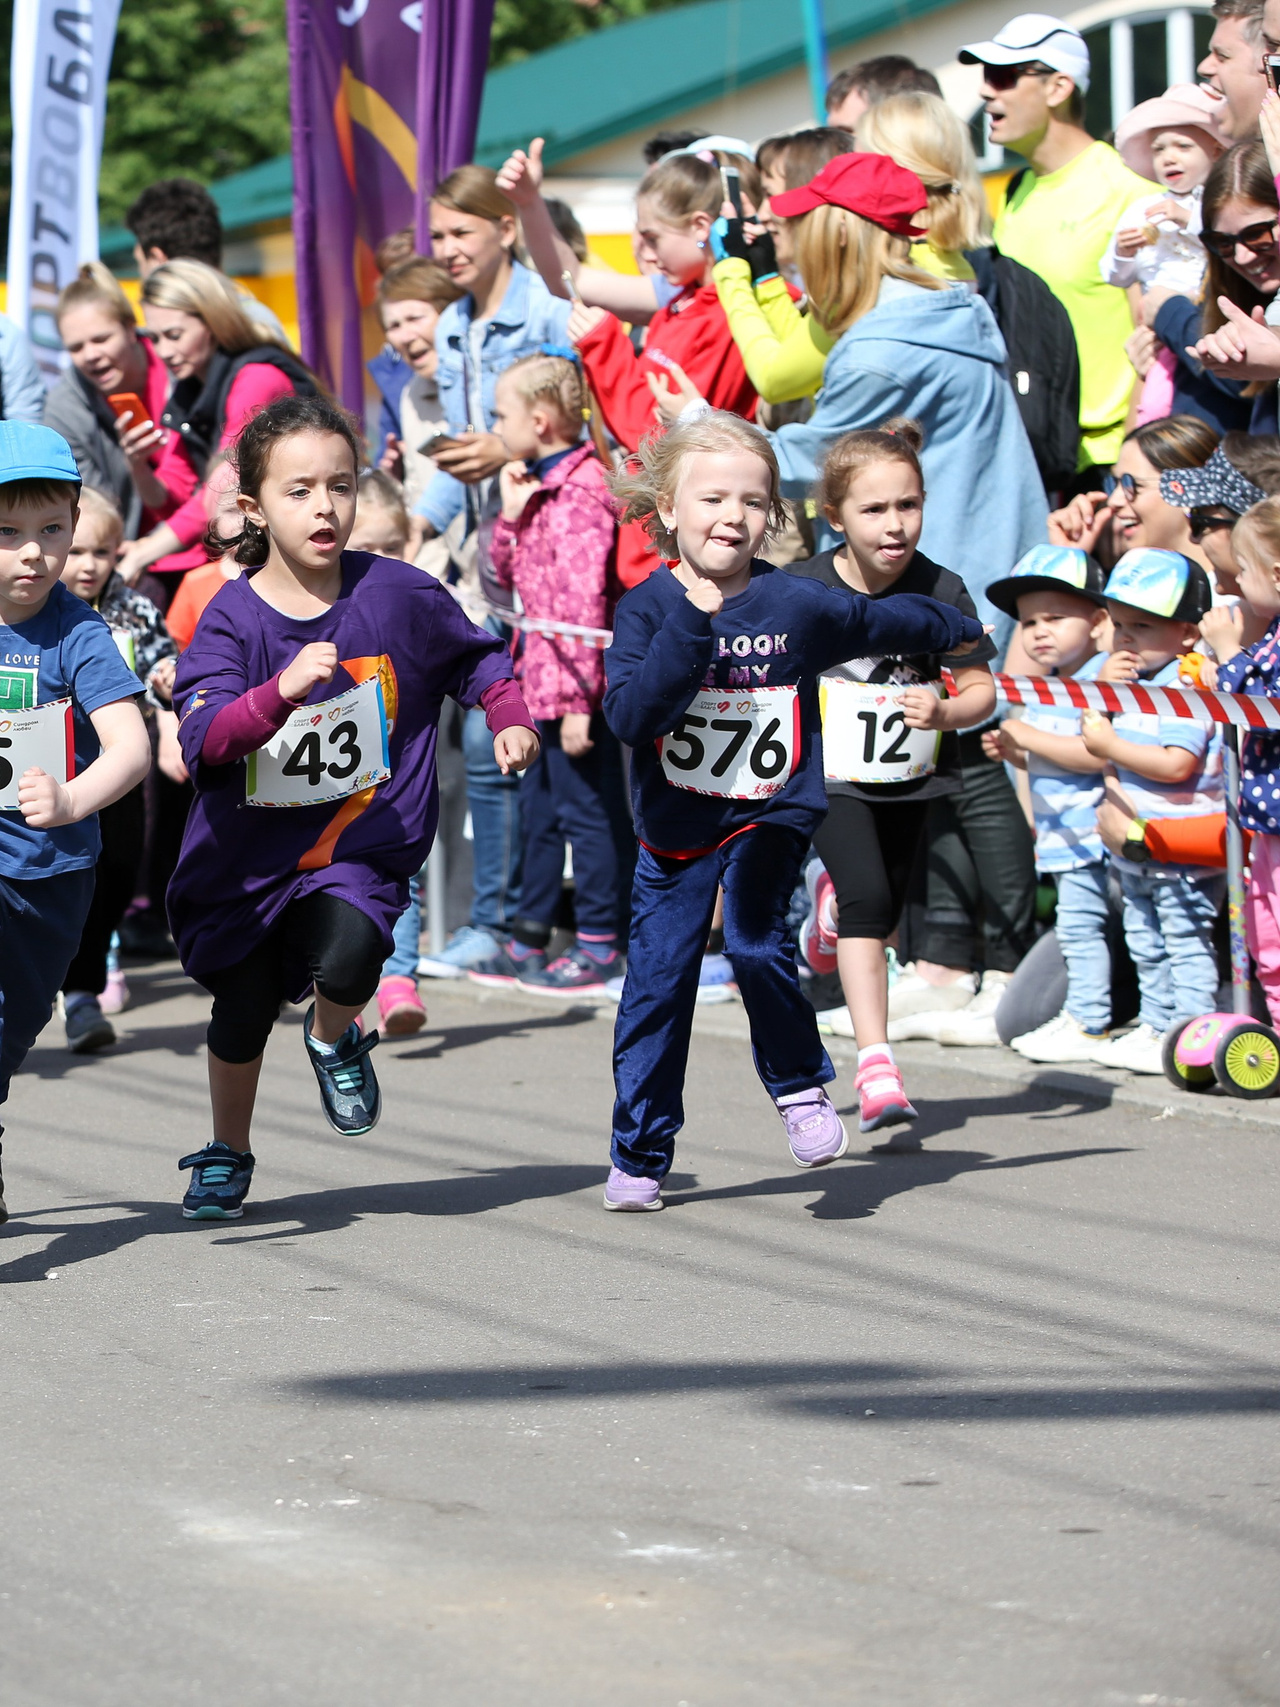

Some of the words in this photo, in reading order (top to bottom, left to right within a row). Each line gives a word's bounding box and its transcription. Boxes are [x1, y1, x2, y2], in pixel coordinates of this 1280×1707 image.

[5, 653, 41, 666] LOVE
[718, 634, 788, 658] LOOK
[728, 663, 770, 686] MY
[282, 720, 362, 787] 43
[666, 713, 788, 780] 576
[857, 711, 912, 764] 12
